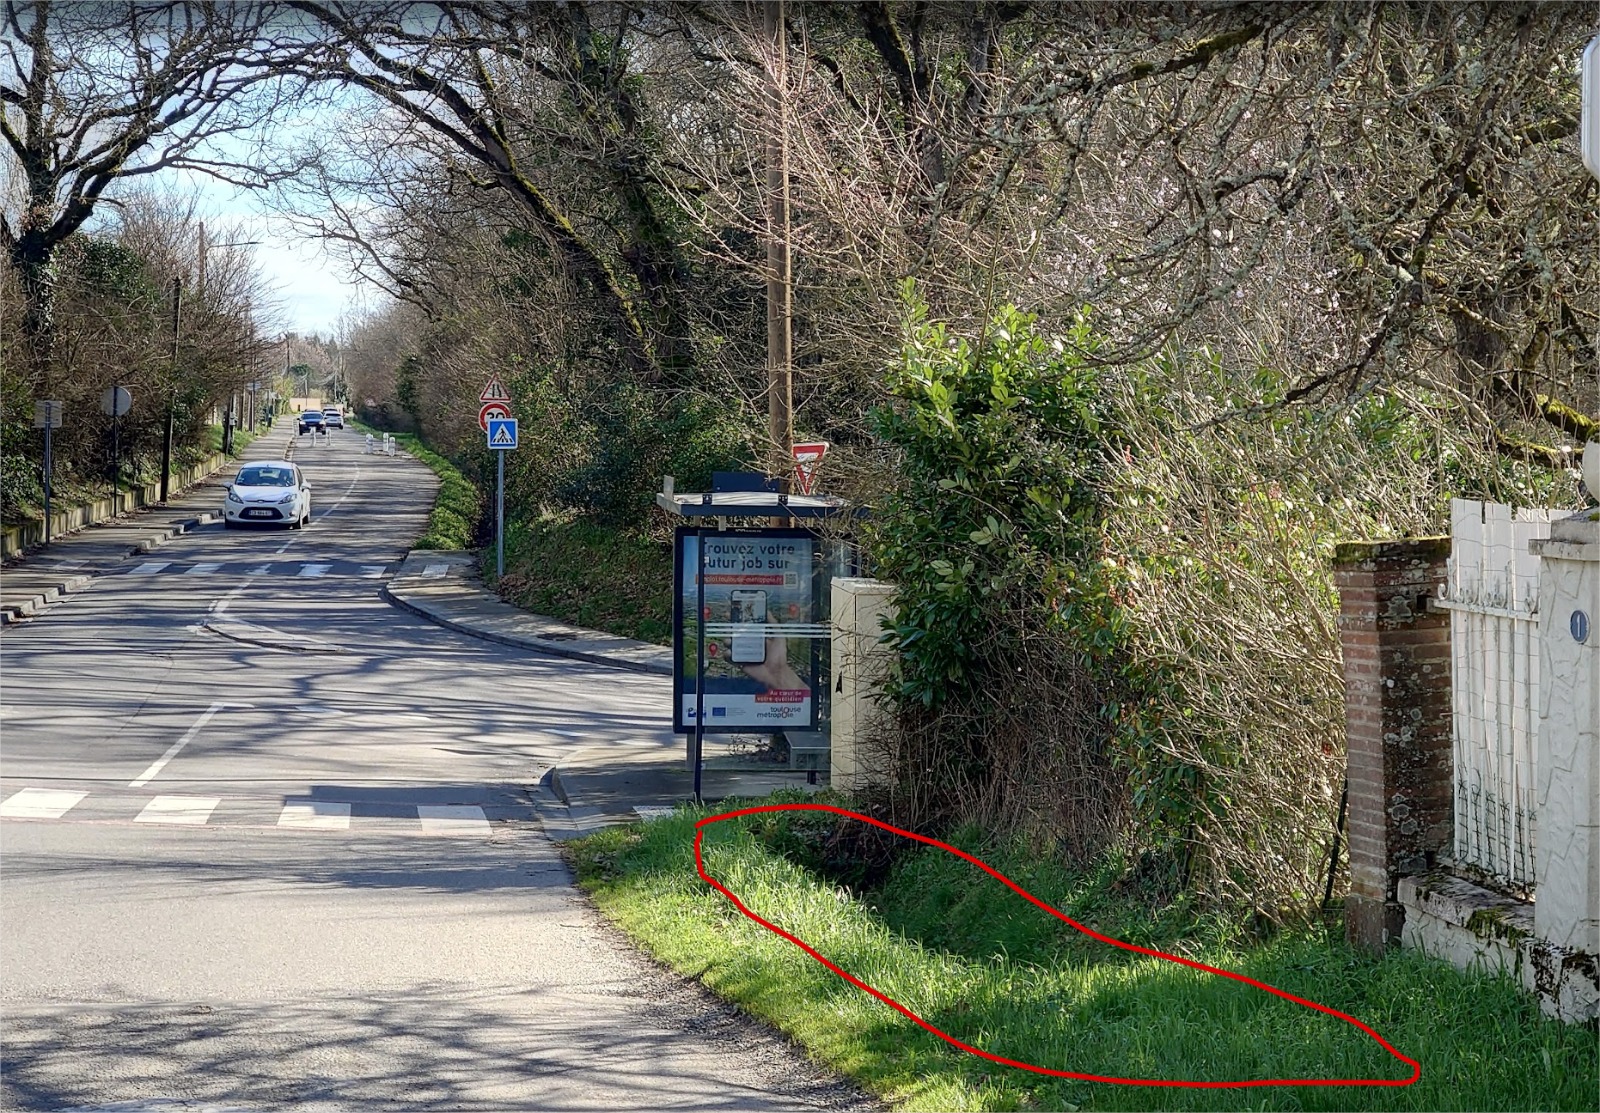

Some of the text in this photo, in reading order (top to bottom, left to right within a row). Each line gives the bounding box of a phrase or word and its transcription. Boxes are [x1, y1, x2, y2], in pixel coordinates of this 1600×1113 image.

[704, 542, 795, 554] rouvez votre
[704, 556, 790, 571] utur job sur
[1576, 614, 1581, 638] 1
